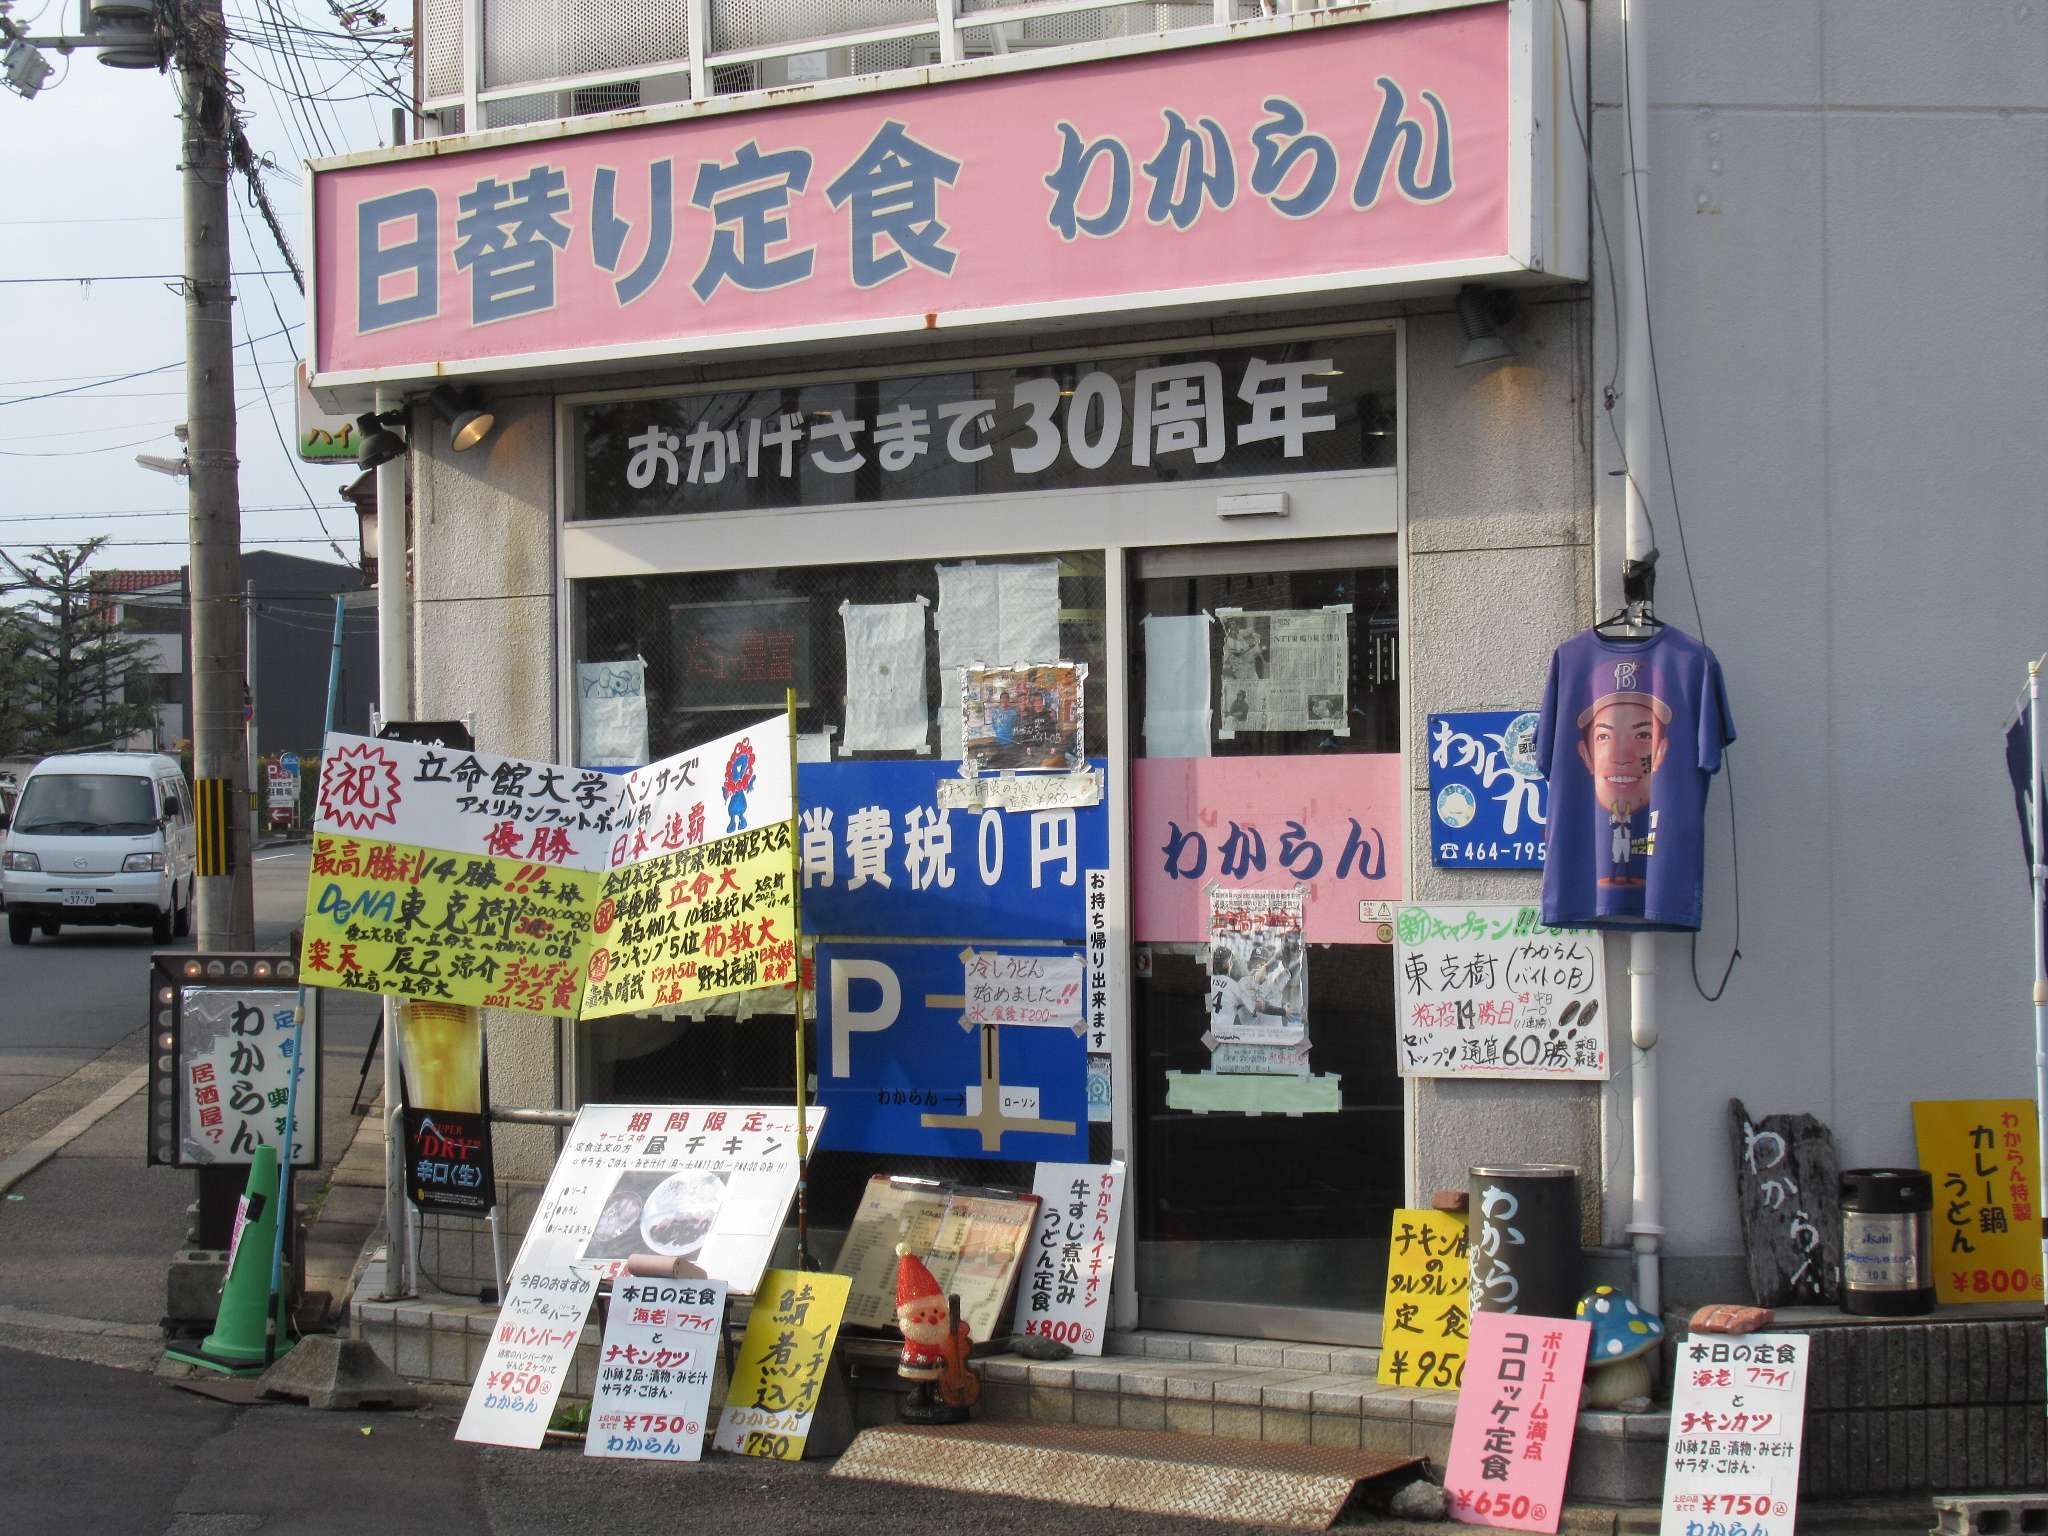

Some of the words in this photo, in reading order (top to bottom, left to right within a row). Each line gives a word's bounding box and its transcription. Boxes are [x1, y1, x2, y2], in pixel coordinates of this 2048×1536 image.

[356, 119, 963, 337] 日替り定食
[1043, 75, 1456, 242] わからん
[626, 357, 1337, 490] おかげさまで30周年
[330, 762, 382, 809] 祝
[413, 751, 608, 810] 立命館大学
[617, 757, 699, 810] パンサーズ
[456, 796, 652, 834] アメリカンフットボール部
[483, 820, 580, 865] 優勝
[1161, 817, 1386, 880] わからん
[666, 867, 741, 909] 立命大
[393, 886, 518, 940] 東克樹
[307, 938, 362, 974] 楽天
[968, 956, 1045, 979] 冷しうどん
[1090, 872, 1107, 1048] お持ち帰り出来ます
[831, 959, 902, 1078] P
[229, 1000, 265, 1155] わからん
[878, 1088, 938, 1107] わからん
[191, 1062, 224, 1144] 居酒屋?
[627, 1112, 768, 1133] 期間限定
[1004, 1097, 1036, 1108] ローソン
[642, 1135, 783, 1155] 昼チキン
[1969, 1125, 2009, 1234] カレー鍋
[2000, 1111, 2032, 1222] わからん特製
[1944, 1173, 1976, 1253] うどん
[1031, 1207, 1061, 1312] うどん定食
[1056, 1178, 1090, 1305] 牛すじ煮込み
[1084, 1173, 1114, 1308] わからんイチオシ
[1480, 1185, 1525, 1314] わから
[520, 1273, 591, 1294] 今月のおすすめ
[1390, 1273, 1469, 1296] タルタルソ
[1426, 1258, 1443, 1273] の
[621, 1285, 717, 1306] 本日の定食
[631, 1306, 667, 1325] 海老
[676, 1312, 716, 1330] フライ
[652, 1331, 663, 1344] と
[1392, 1302, 1469, 1339] 定食
[604, 1343, 690, 1369] チキンカツ
[794, 1323, 832, 1419] イチオシ
[1689, 1343, 1796, 1364] 本日の定食
[1523, 1331, 1563, 1461] ボリューム満点
[1692, 1368, 1732, 1387] 海老
[1747, 1367, 1790, 1387] フライ
[484, 1393, 538, 1413] わからん
[729, 1408, 799, 1432] わからん
[1480, 1331, 1529, 1482] コロッケ定食
[1732, 1394, 1744, 1408] と
[1681, 1411, 1773, 1433] チキンカツ
[607, 1434, 681, 1455] わからん
